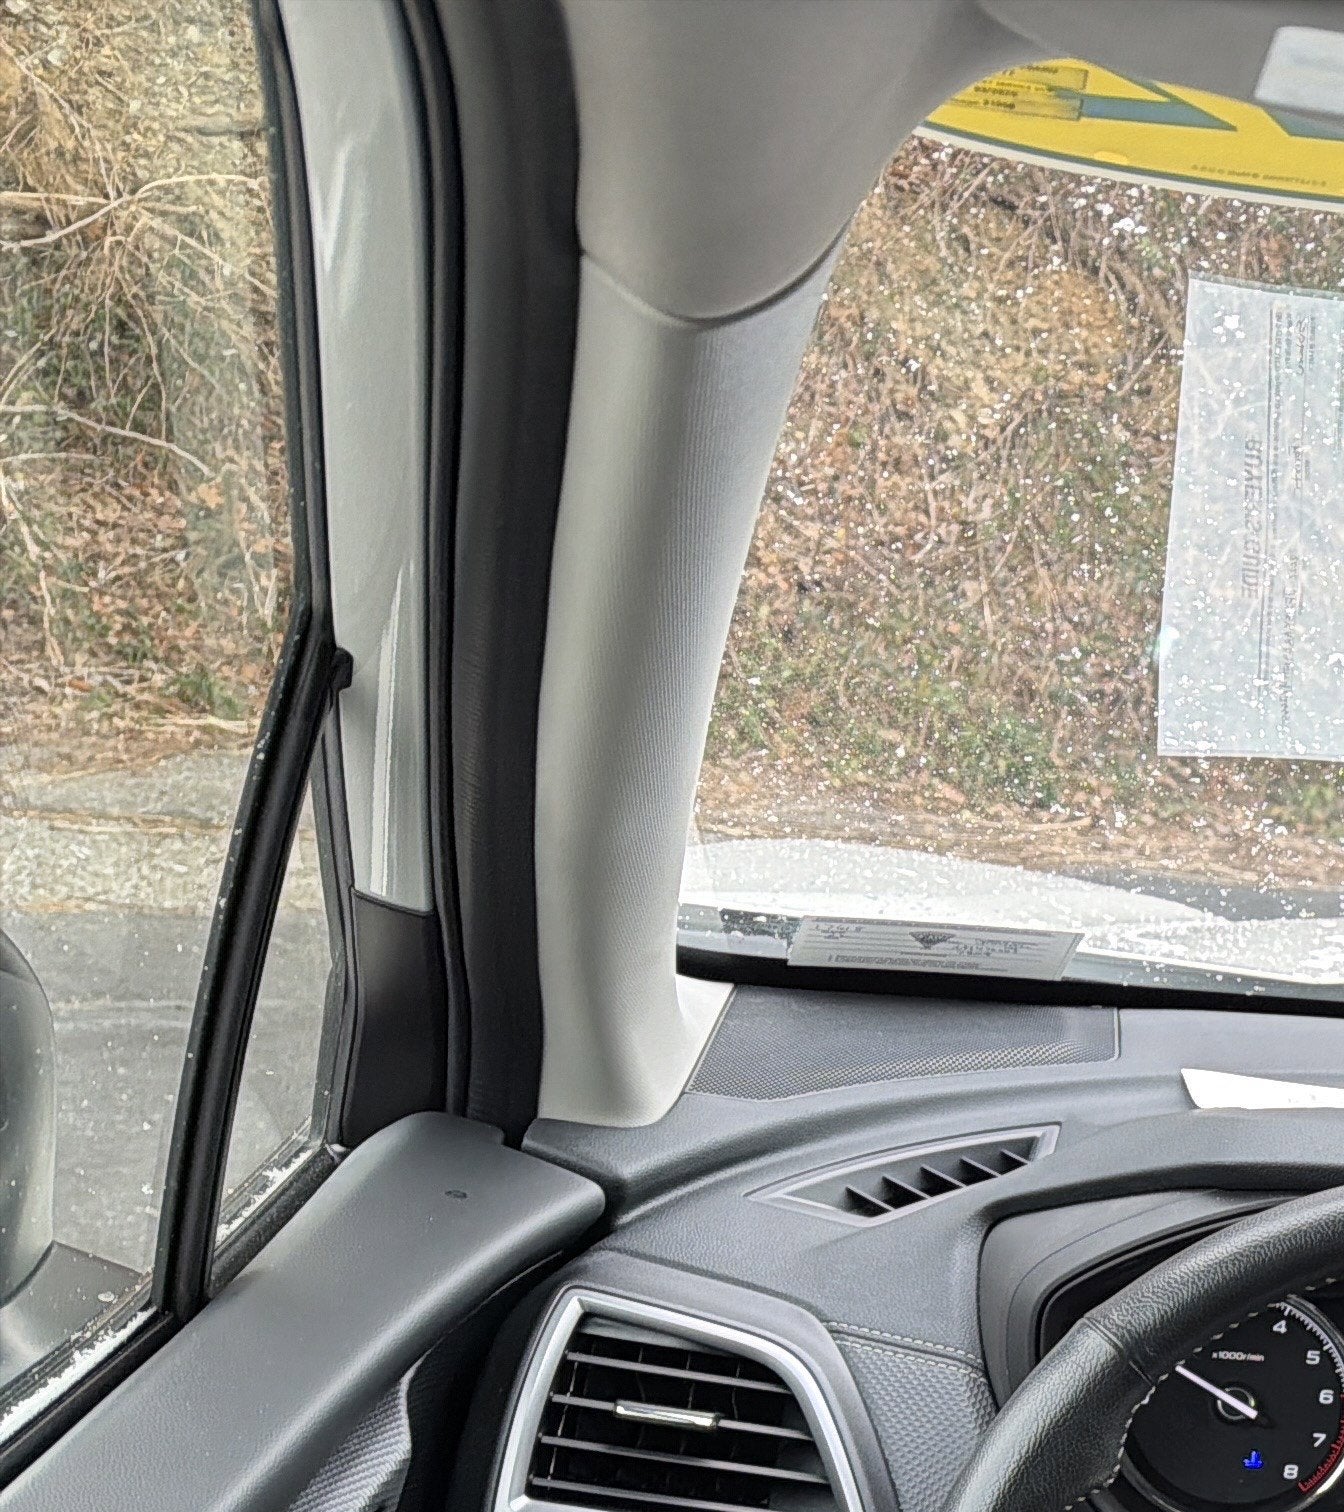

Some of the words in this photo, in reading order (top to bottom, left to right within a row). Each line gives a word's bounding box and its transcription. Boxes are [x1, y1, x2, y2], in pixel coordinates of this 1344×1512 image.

[1272, 1319, 1288, 1334] 4
[1305, 1350, 1320, 1365] 5
[1318, 1389, 1334, 1404] 6
[1312, 1432, 1327, 1448] 7
[1283, 1463, 1299, 1480] 8
